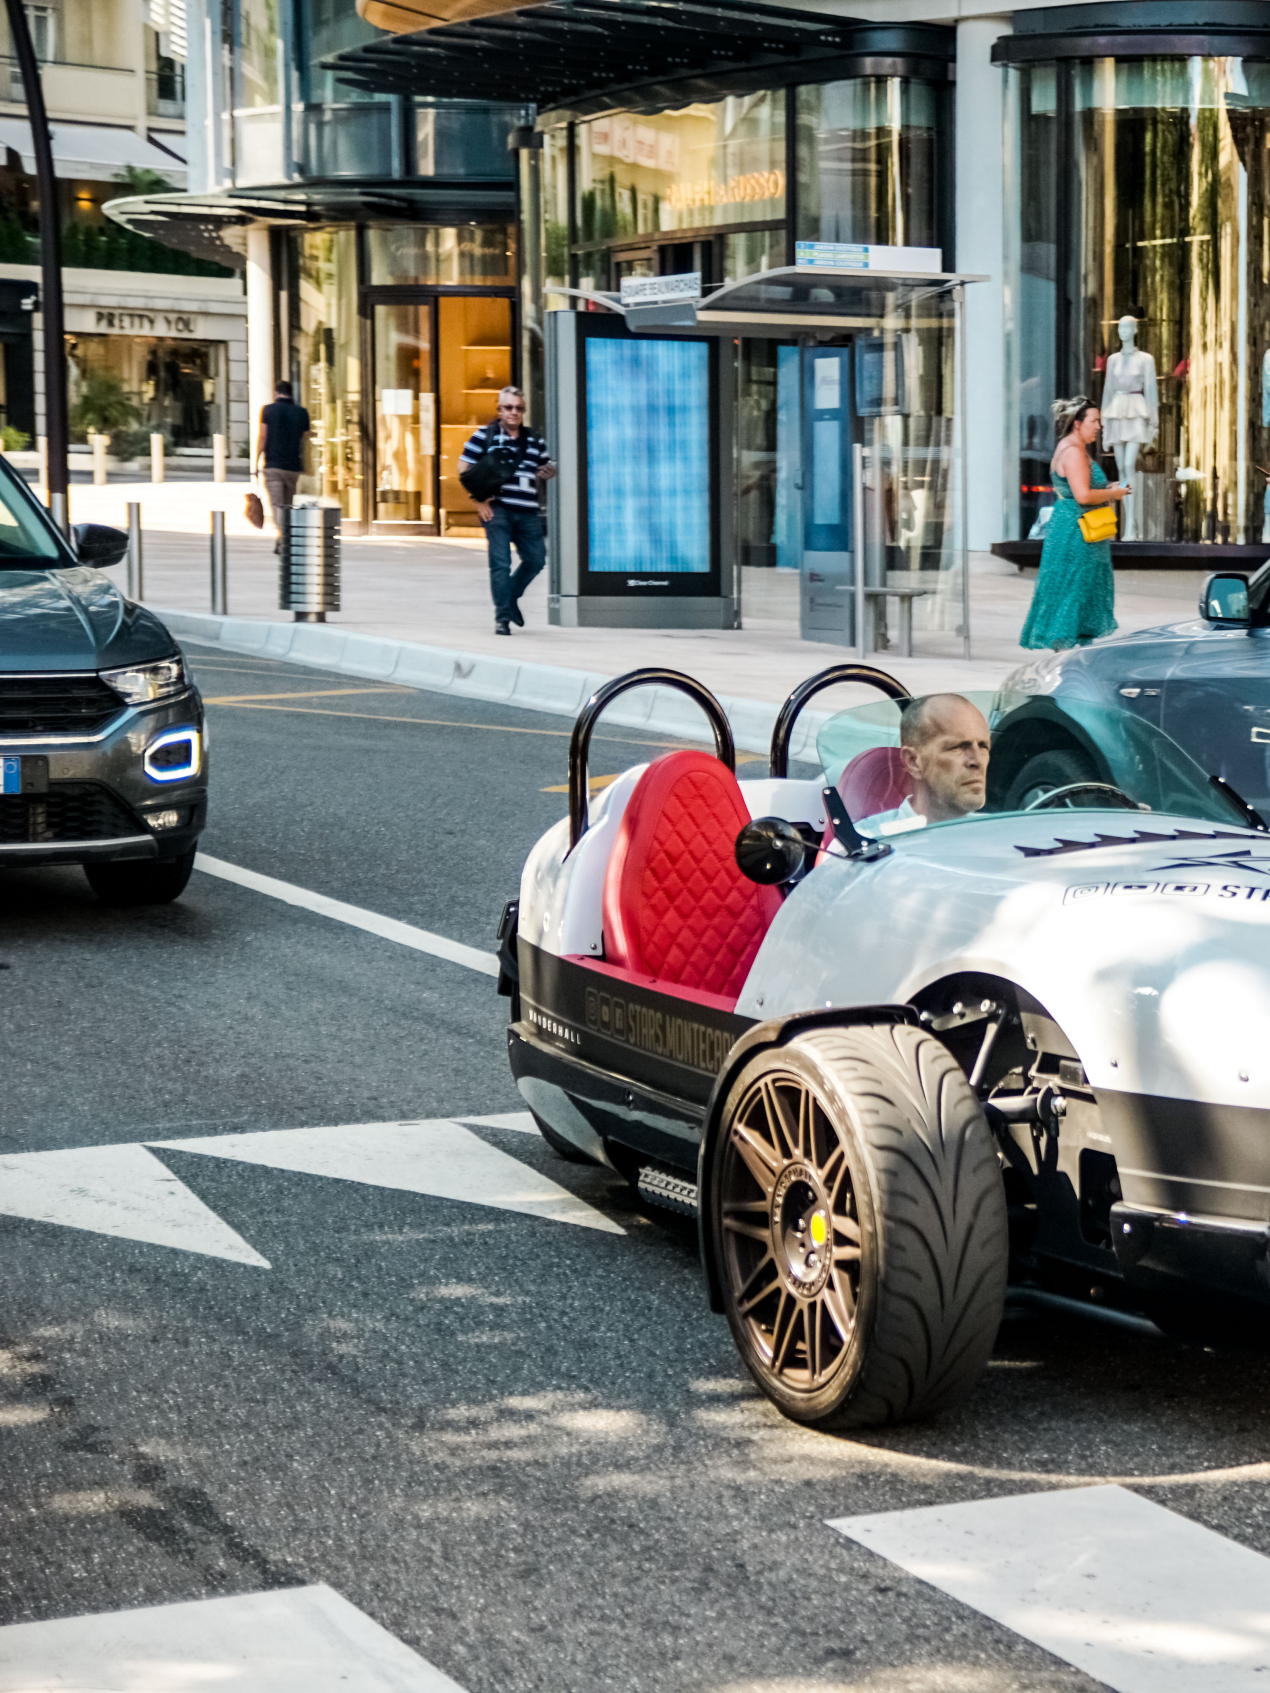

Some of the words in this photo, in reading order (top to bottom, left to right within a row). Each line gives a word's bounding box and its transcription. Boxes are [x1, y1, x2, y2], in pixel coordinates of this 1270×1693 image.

[622, 283, 647, 299] SQUARE
[648, 277, 699, 296] BEAUMARCHAIS
[96, 311, 155, 331] PRETTY
[163, 315, 198, 333] YOU
[529, 1009, 581, 1045] VANDERHALL
